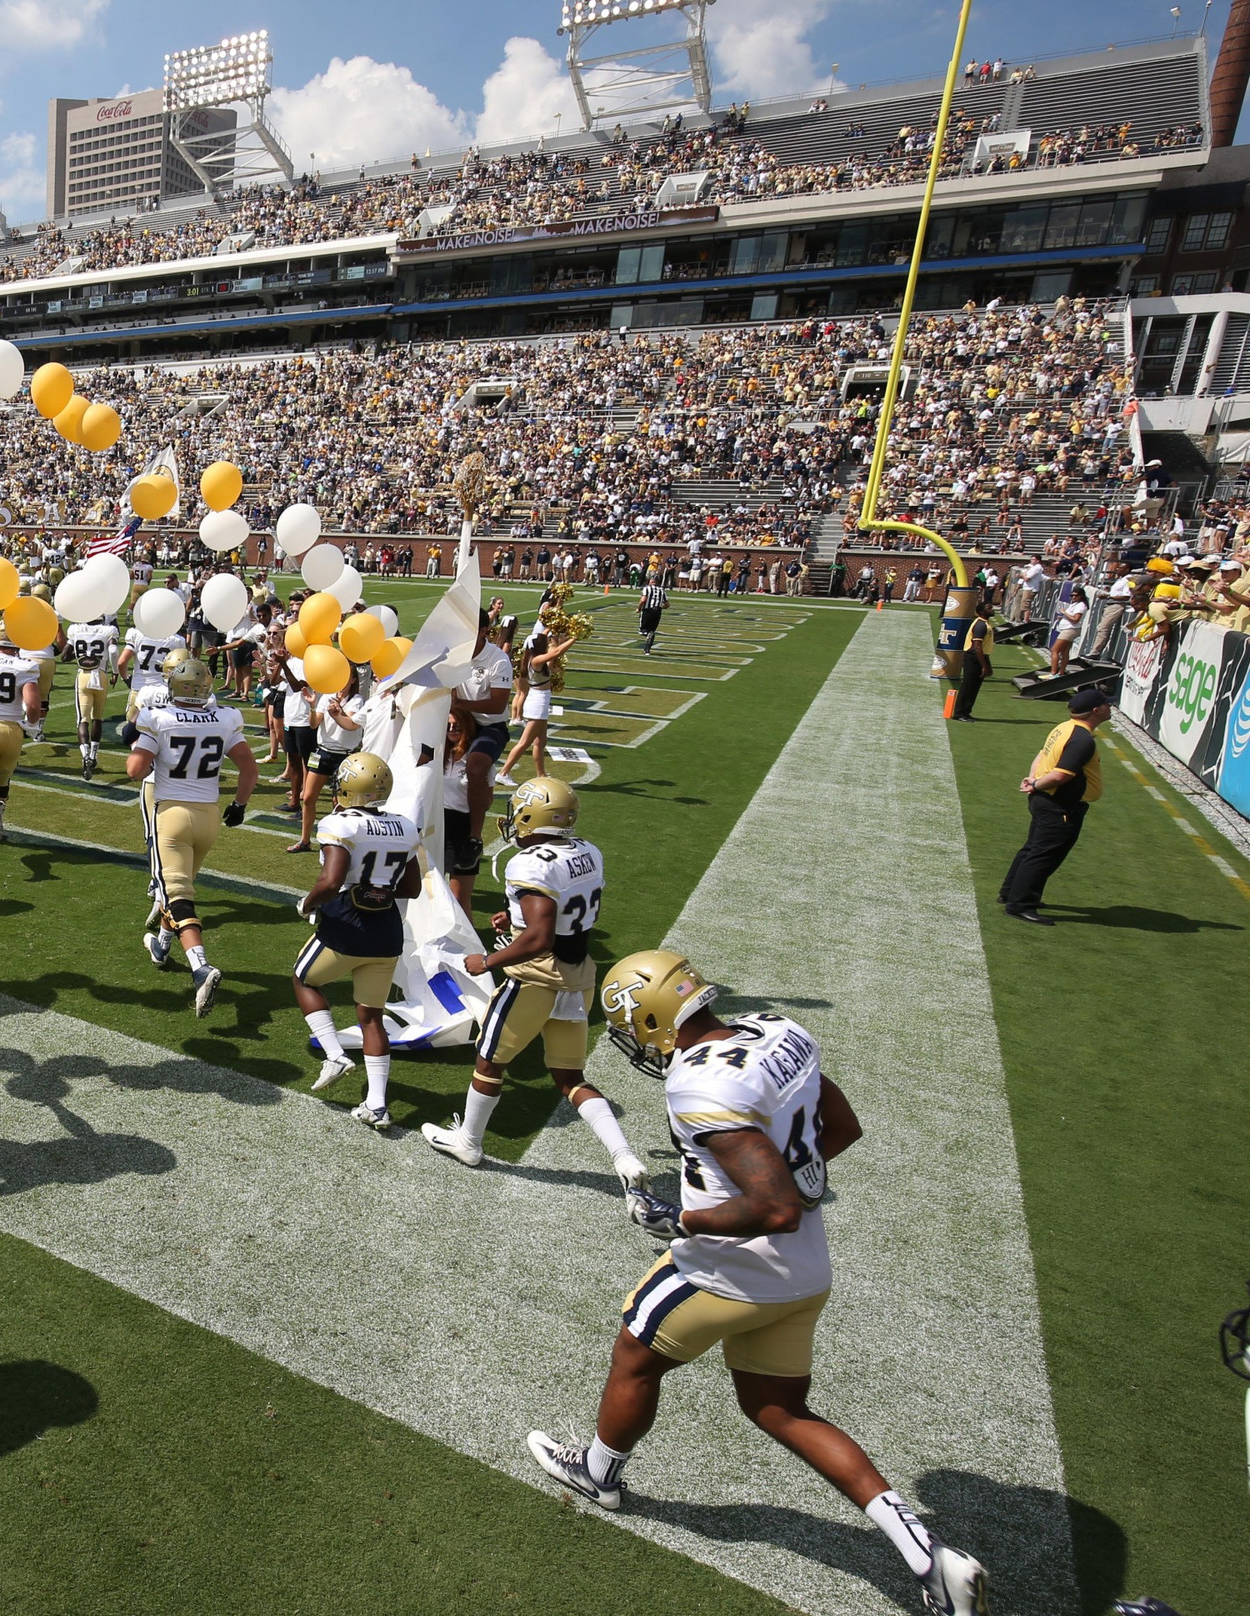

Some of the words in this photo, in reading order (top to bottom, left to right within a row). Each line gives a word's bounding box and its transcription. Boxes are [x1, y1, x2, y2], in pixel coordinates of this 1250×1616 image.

[97, 100, 133, 121] Coca-Cola
[575, 217, 614, 235] MAKE
[614, 212, 660, 232] NOISE!
[436, 235, 470, 250] MAKE
[474, 228, 515, 248] NOISE!
[134, 569, 144, 581] 51
[1169, 652, 1216, 734] sage
[175, 710, 219, 723] CLARK
[168, 735, 225, 779] 72
[516, 781, 545, 807] GT
[366, 819, 405, 837] AUSTIN
[359, 850, 409, 887] 17
[565, 852, 596, 880] ASKEW
[601, 981, 644, 1013] GT
[683, 1045, 748, 1070] 44
[759, 1028, 814, 1090] KAGAWA
